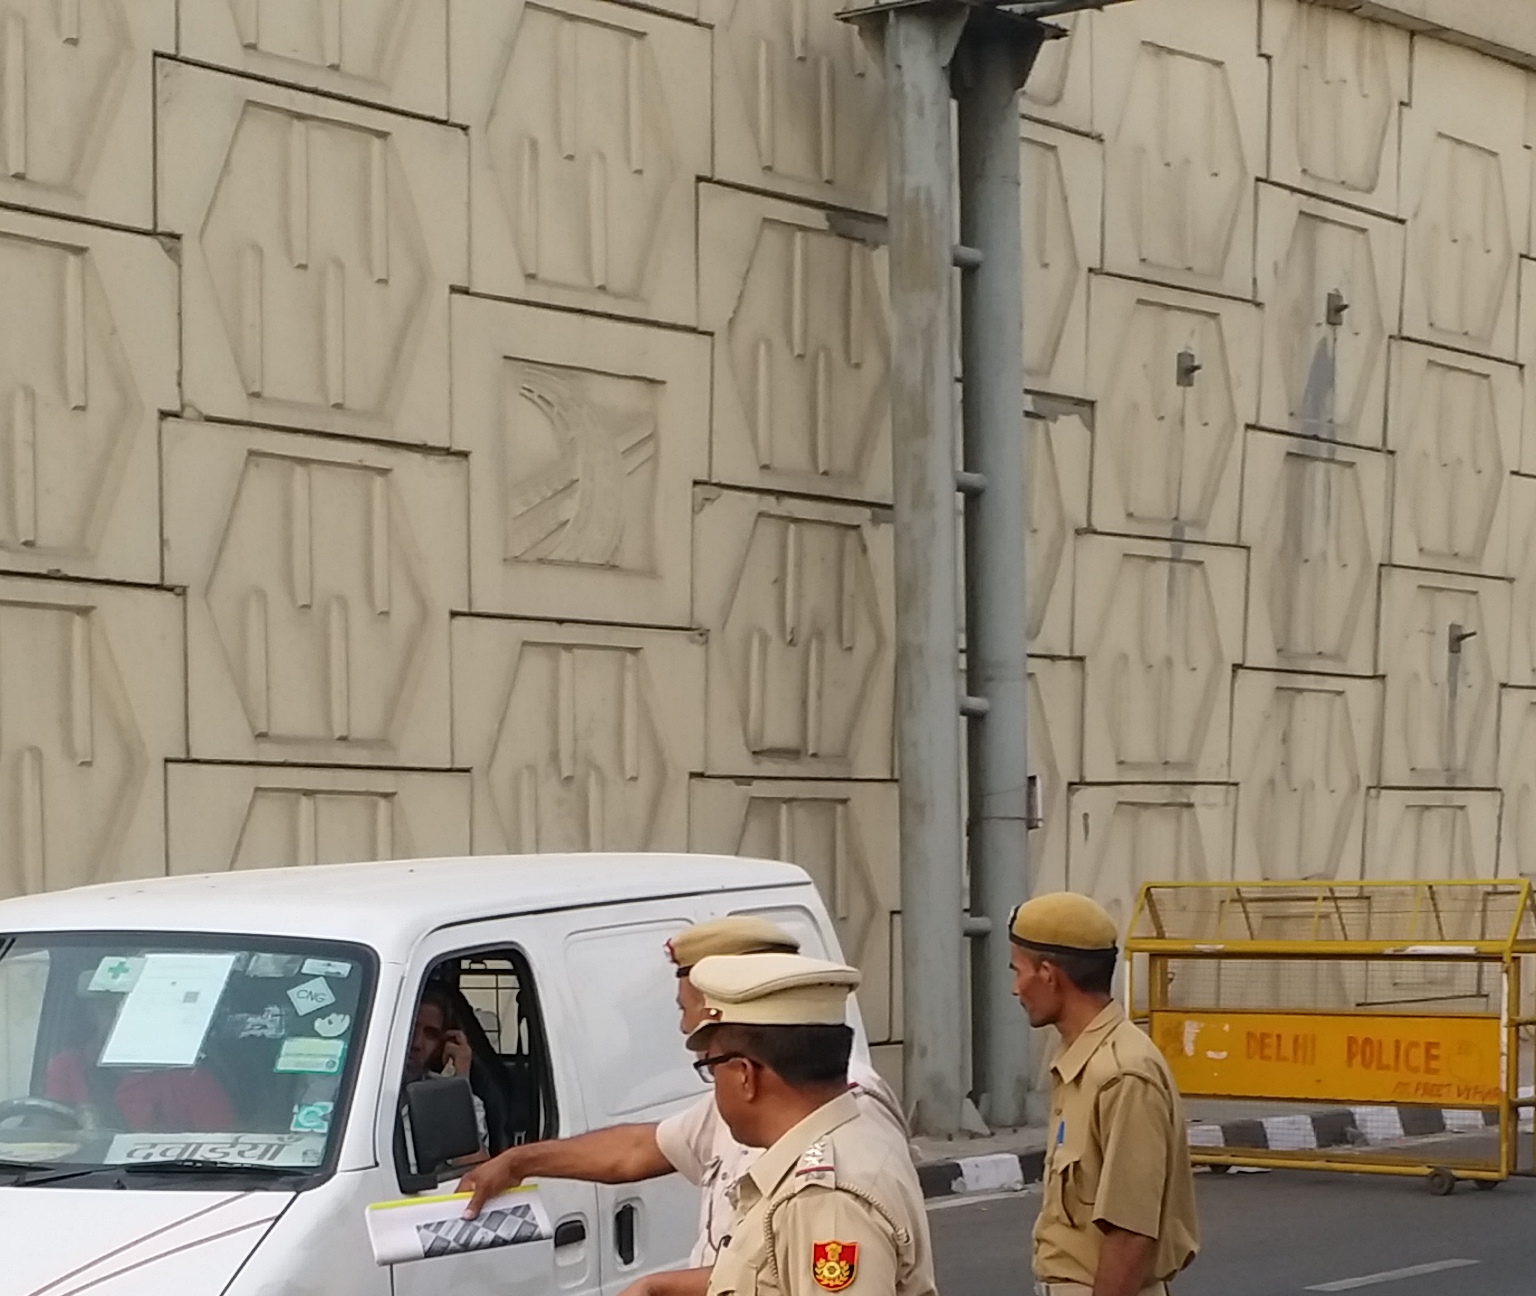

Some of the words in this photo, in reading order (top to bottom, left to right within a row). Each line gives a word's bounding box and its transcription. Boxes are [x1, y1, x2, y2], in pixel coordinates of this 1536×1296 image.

[296, 988, 326, 1003] CNG
[1245, 1030, 1317, 1065] DELHI
[1346, 1035, 1441, 1075] POLICE
